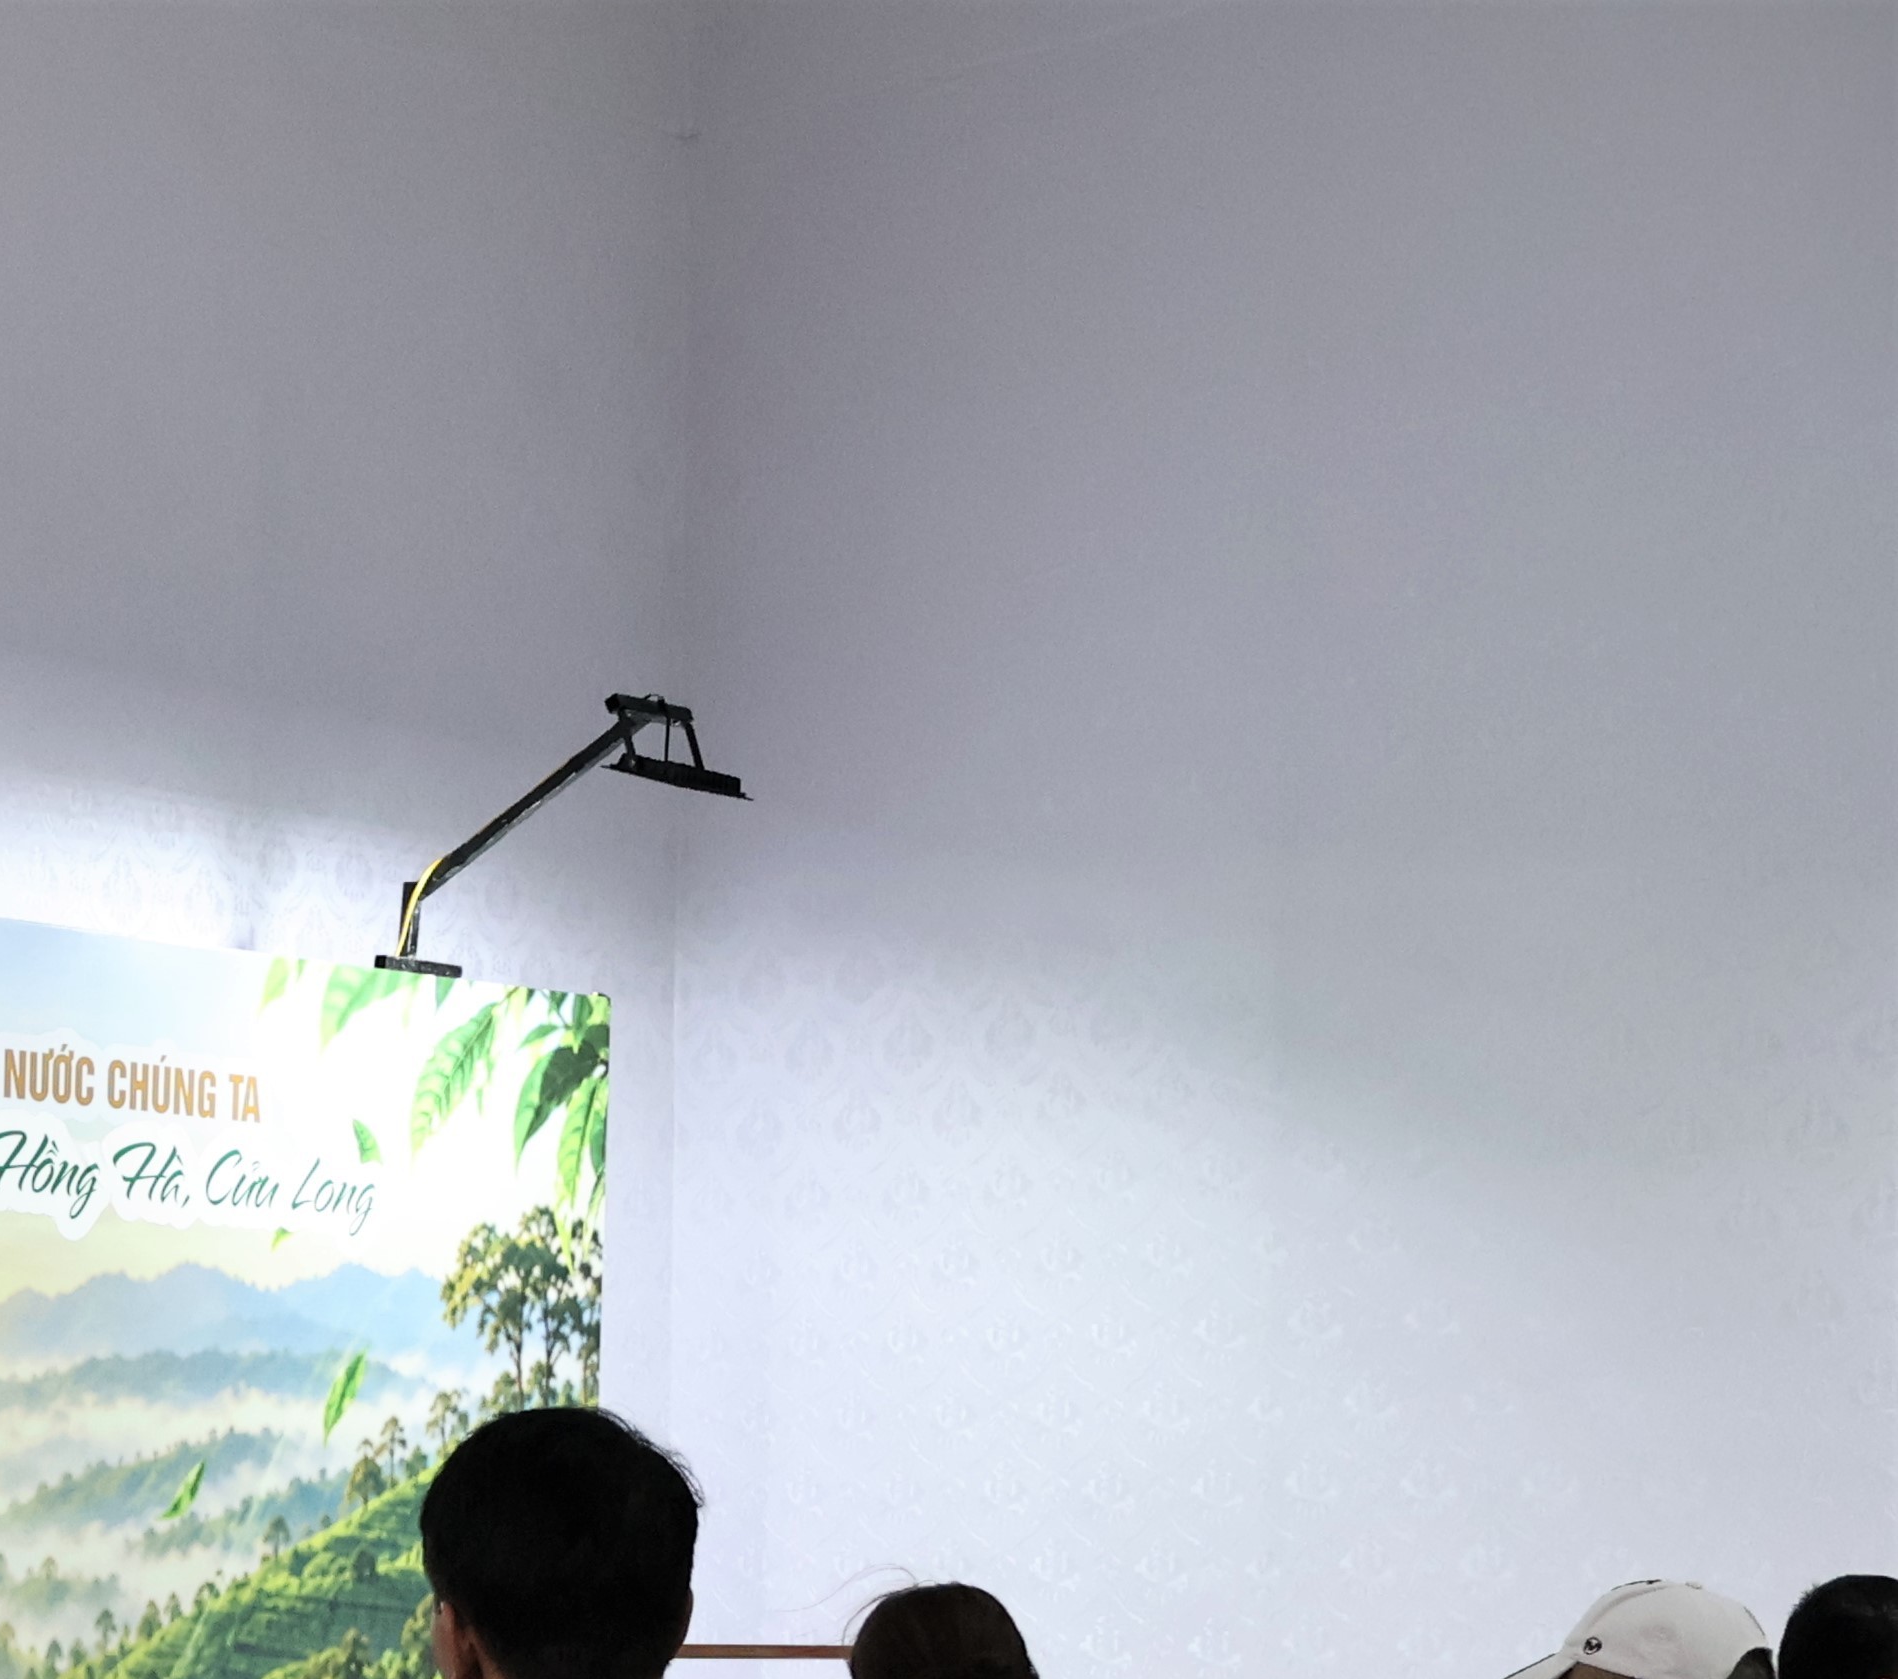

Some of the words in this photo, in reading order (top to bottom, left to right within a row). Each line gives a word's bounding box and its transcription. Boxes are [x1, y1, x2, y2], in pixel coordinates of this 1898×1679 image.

[4, 1040, 95, 1105] NƯỚC
[107, 1054, 216, 1118] CHÚNG
[228, 1073, 262, 1123] TA
[113, 1132, 189, 1207] Hà,
[291, 1158, 376, 1227] Long
